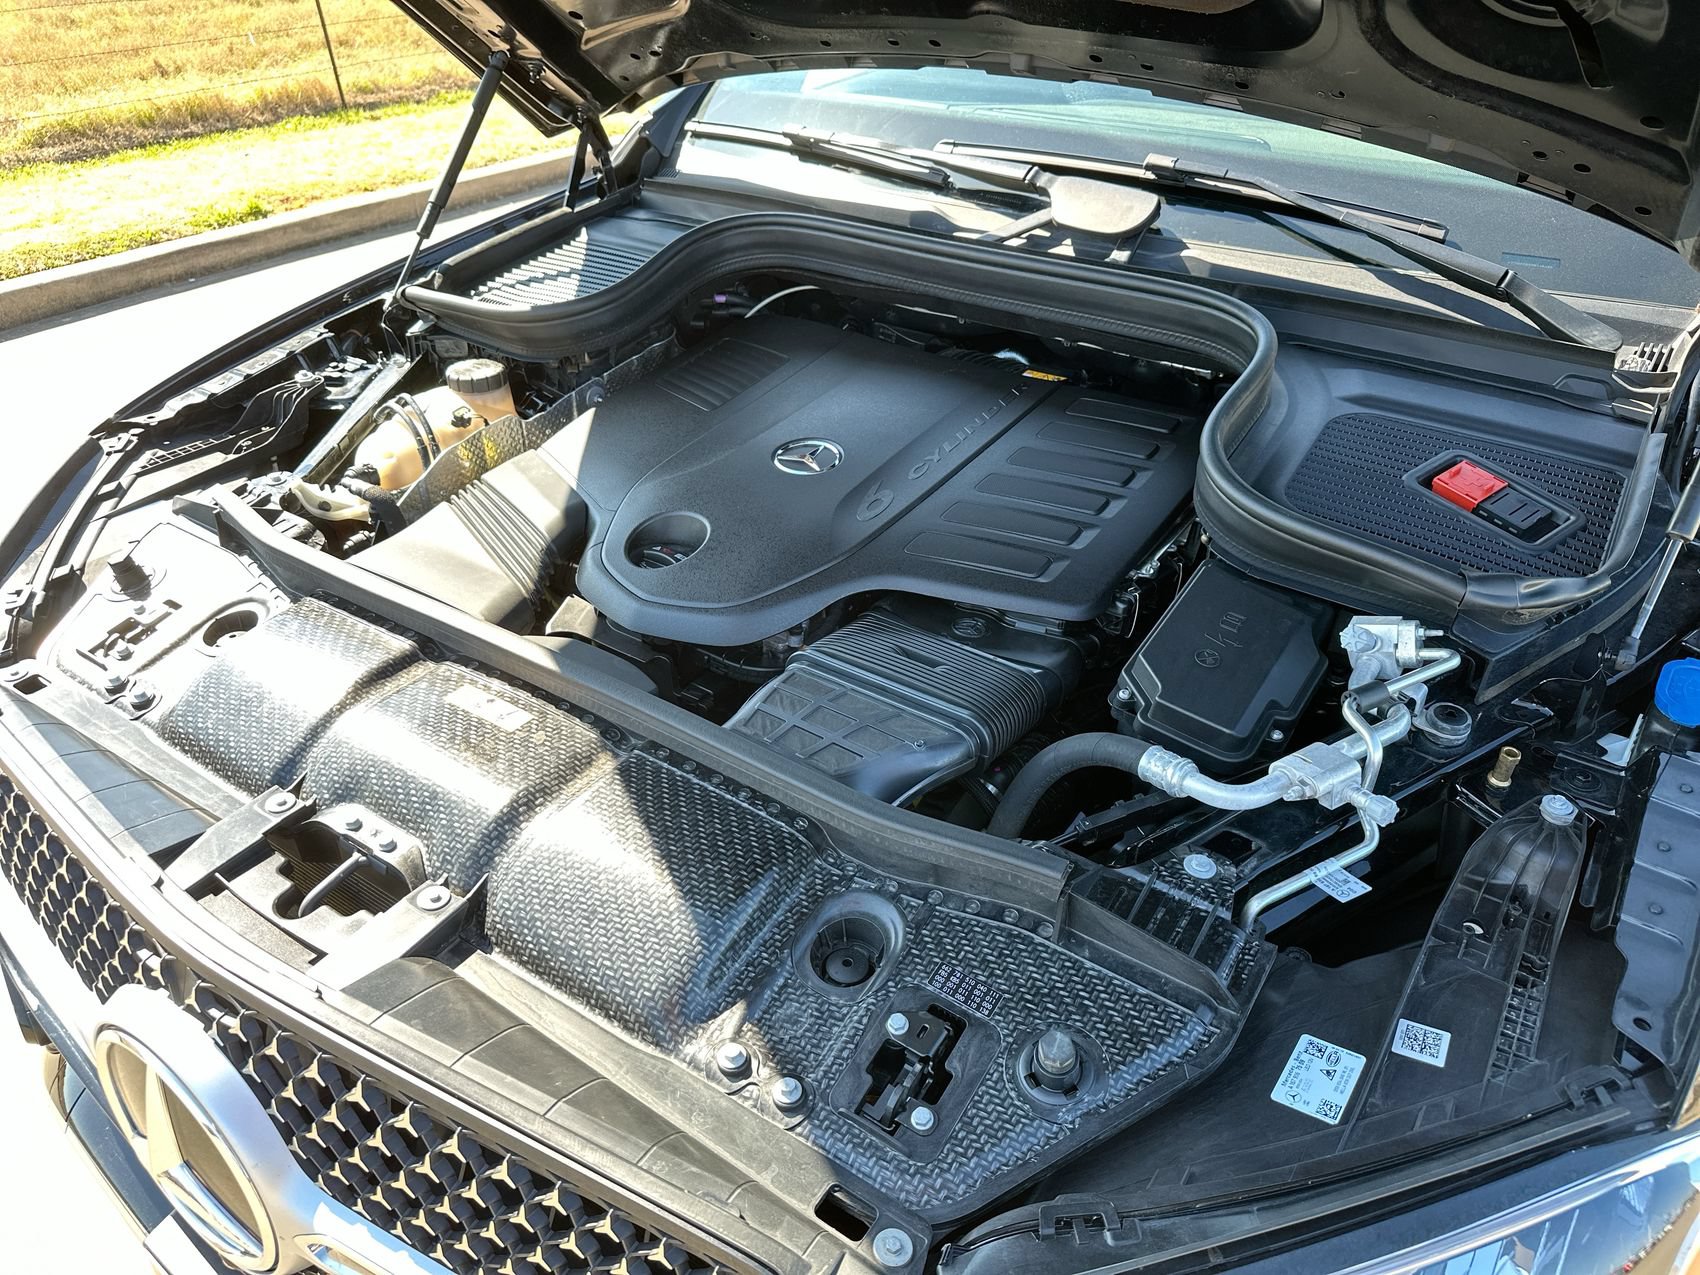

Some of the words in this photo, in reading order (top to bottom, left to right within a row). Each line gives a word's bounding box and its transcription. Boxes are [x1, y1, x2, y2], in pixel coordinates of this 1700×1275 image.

[857, 480, 894, 521] 6
[962, 983, 972, 991] 011
[986, 996, 996, 1004] 011
[989, 990, 1000, 999] 111
[970, 994, 981, 1003] 110
[967, 1000, 977, 1008] 110
